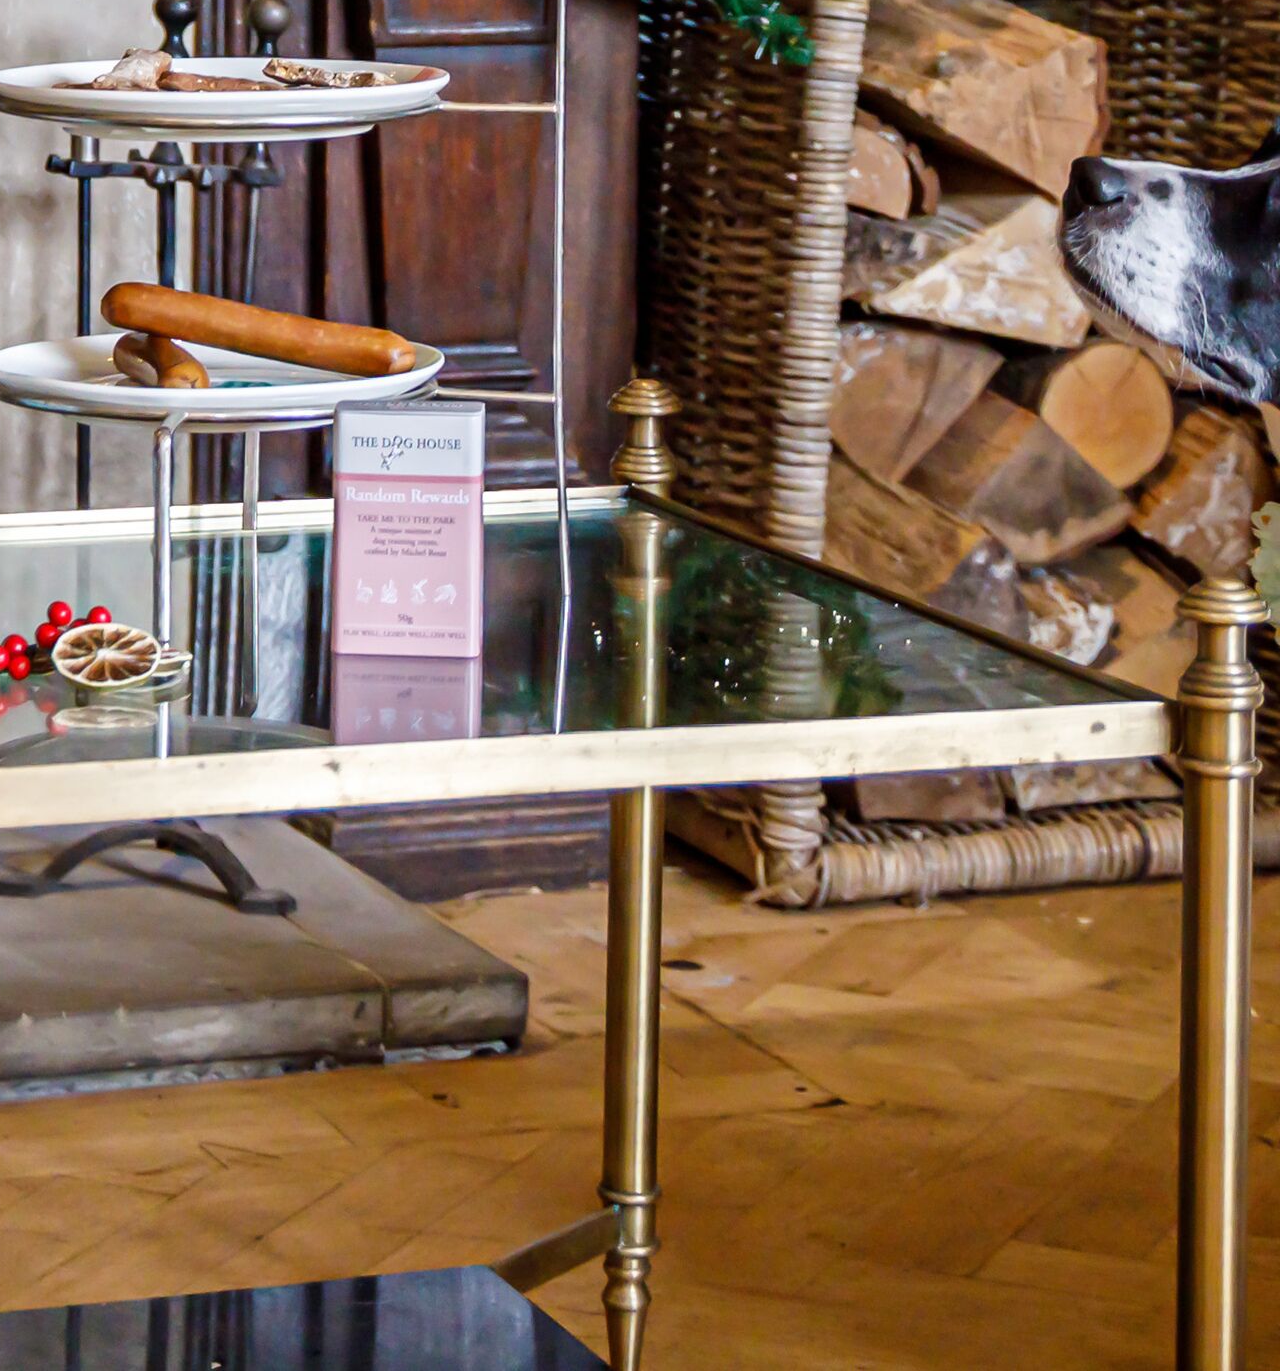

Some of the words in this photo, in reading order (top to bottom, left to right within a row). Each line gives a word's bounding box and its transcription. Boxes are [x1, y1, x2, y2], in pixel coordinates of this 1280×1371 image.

[352, 436, 378, 448] THE
[381, 435, 413, 449] DOG
[417, 438, 462, 450] HOUSE
[346, 486, 406, 503] Random
[410, 488, 470, 505] Rewards
[357, 515, 378, 523] TAKE
[381, 515, 394, 523] ME
[413, 516, 431, 524] THE
[433, 516, 456, 524] PARK
[398, 614, 414, 625] 50g
